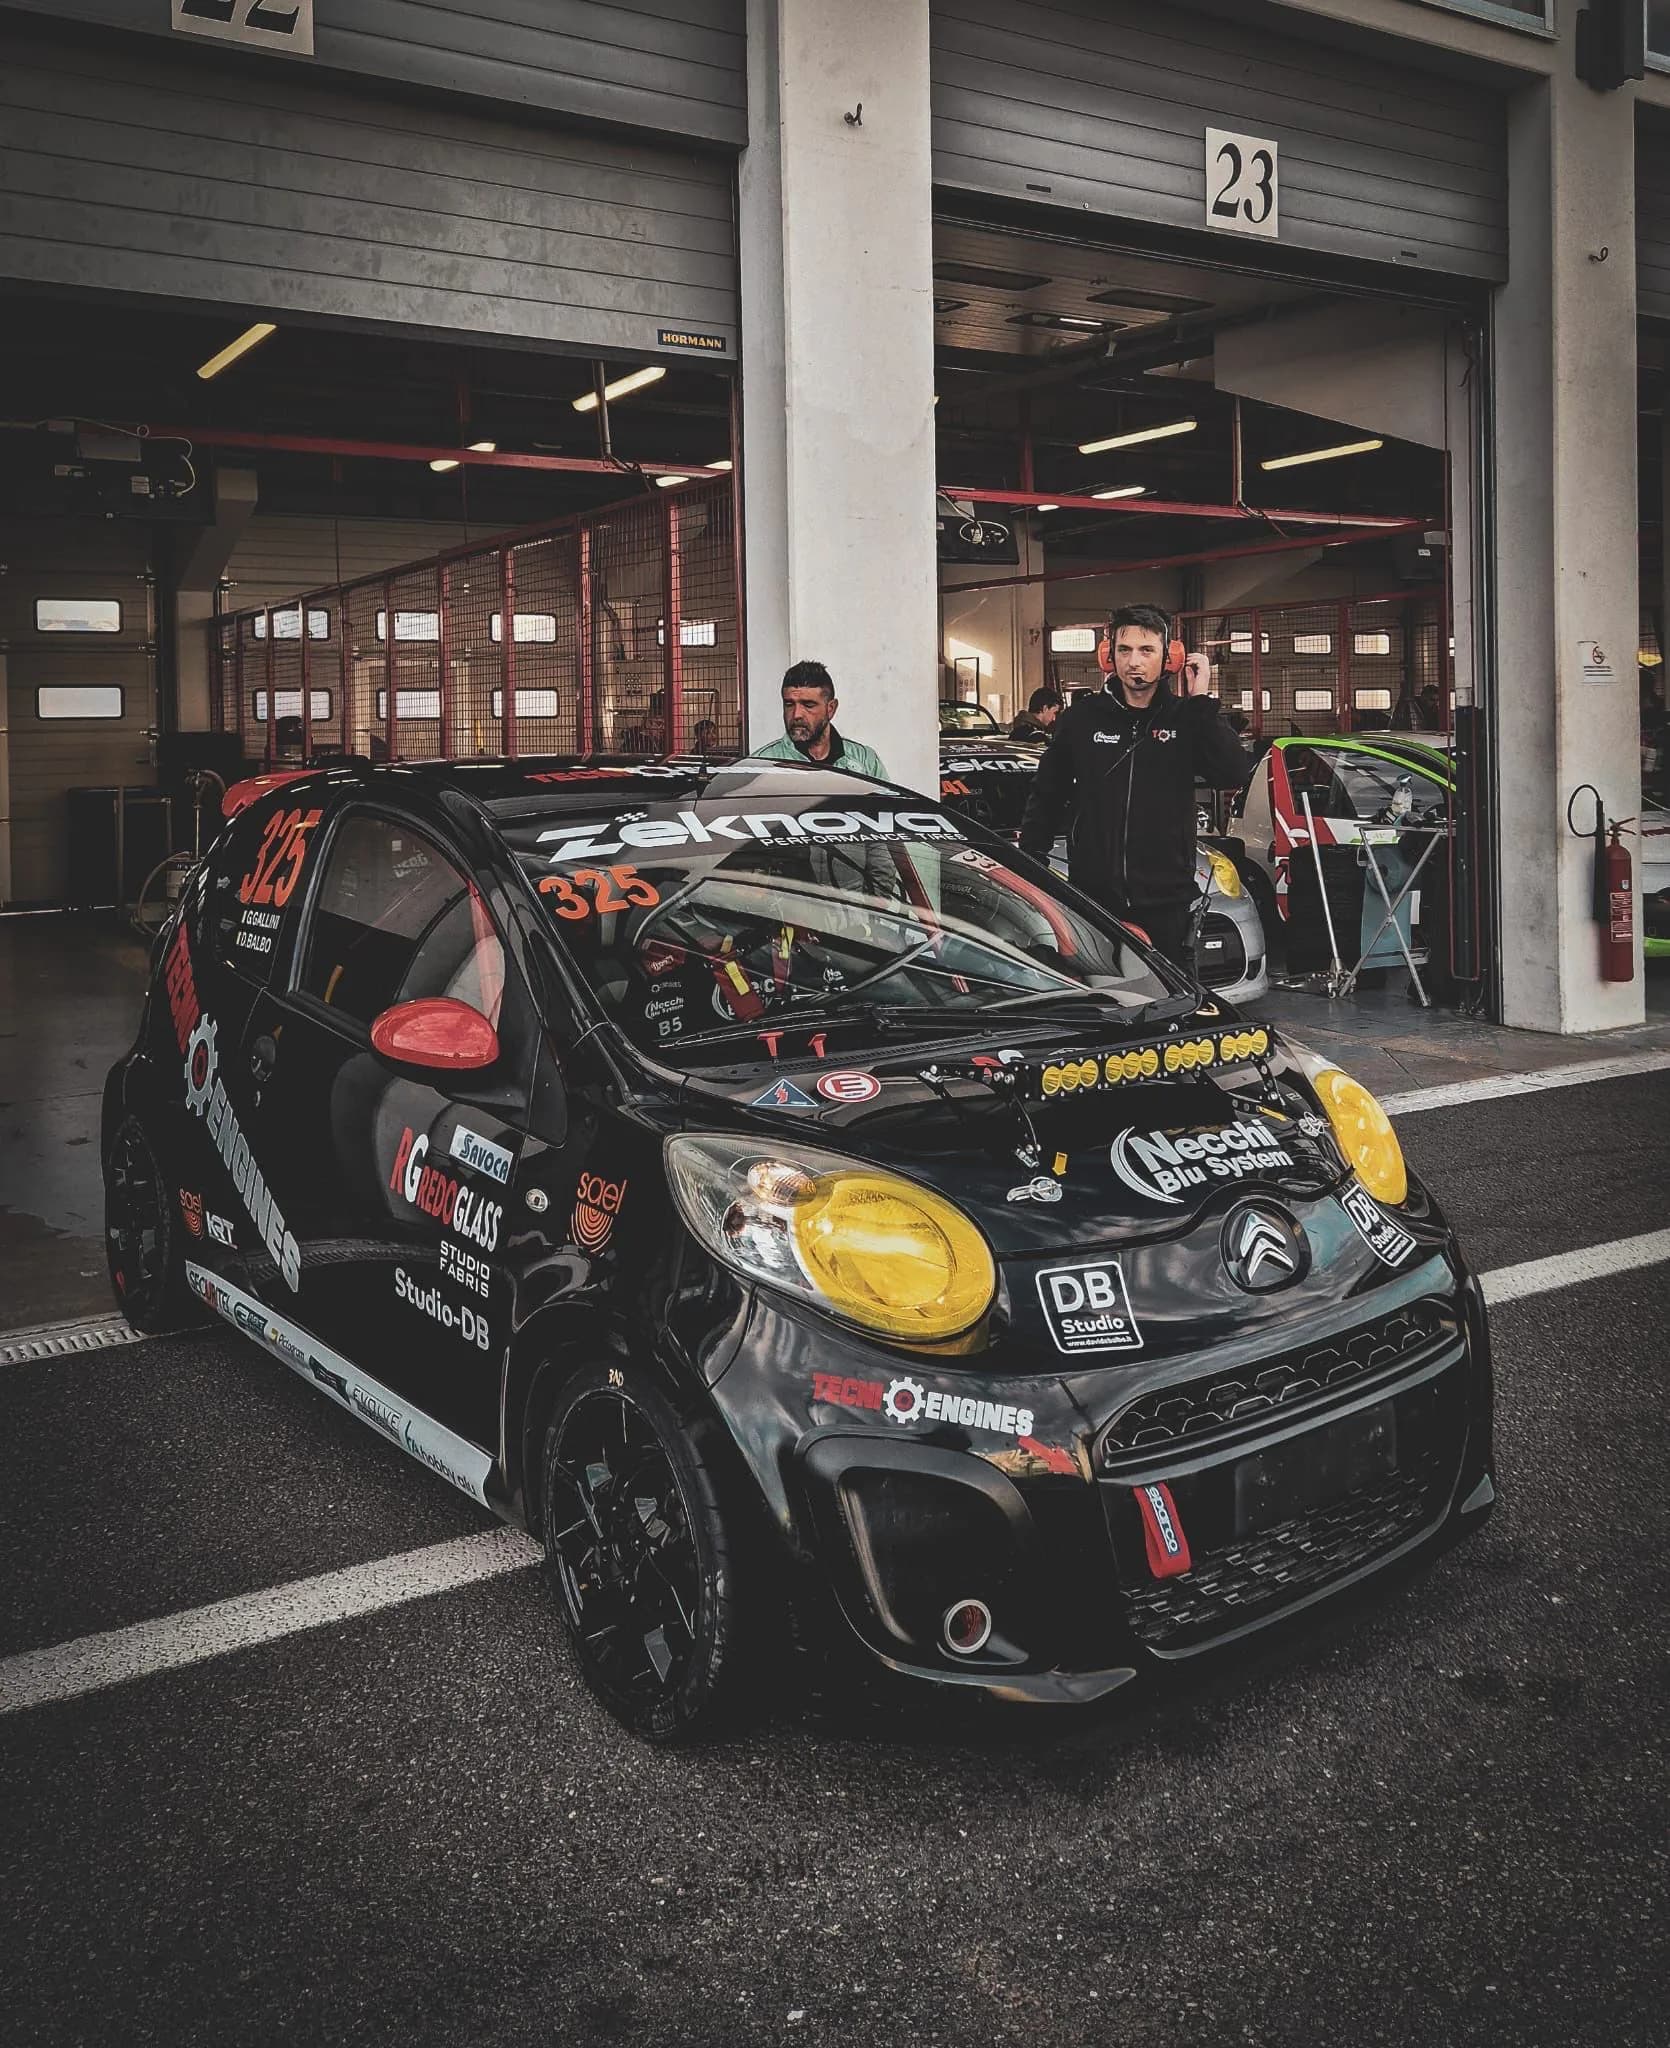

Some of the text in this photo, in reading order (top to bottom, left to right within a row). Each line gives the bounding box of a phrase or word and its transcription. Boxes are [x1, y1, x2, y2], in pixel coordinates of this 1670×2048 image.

[1212, 142, 1274, 223] 23
[239, 808, 324, 908] 325
[759, 832, 969, 848] PERFORMANCE TIRES
[538, 863, 661, 921] 325
[658, 1016, 683, 1036] B5
[830, 1077, 868, 1094] E
[1127, 1119, 1280, 1174] Necchi
[206, 1078, 301, 1293] ENGINES
[577, 1171, 627, 1215] sael
[1153, 1150, 1295, 1195] Blu System
[1347, 1192, 1380, 1233] DB
[440, 1240, 490, 1281] STUDIO
[440, 1257, 489, 1298] FABRIS
[395, 1267, 489, 1351] Studio-DB
[1049, 1270, 1116, 1314] DB
[1061, 1314, 1125, 1335] Studio
[812, 1371, 1035, 1437] TECNI ENGINES
